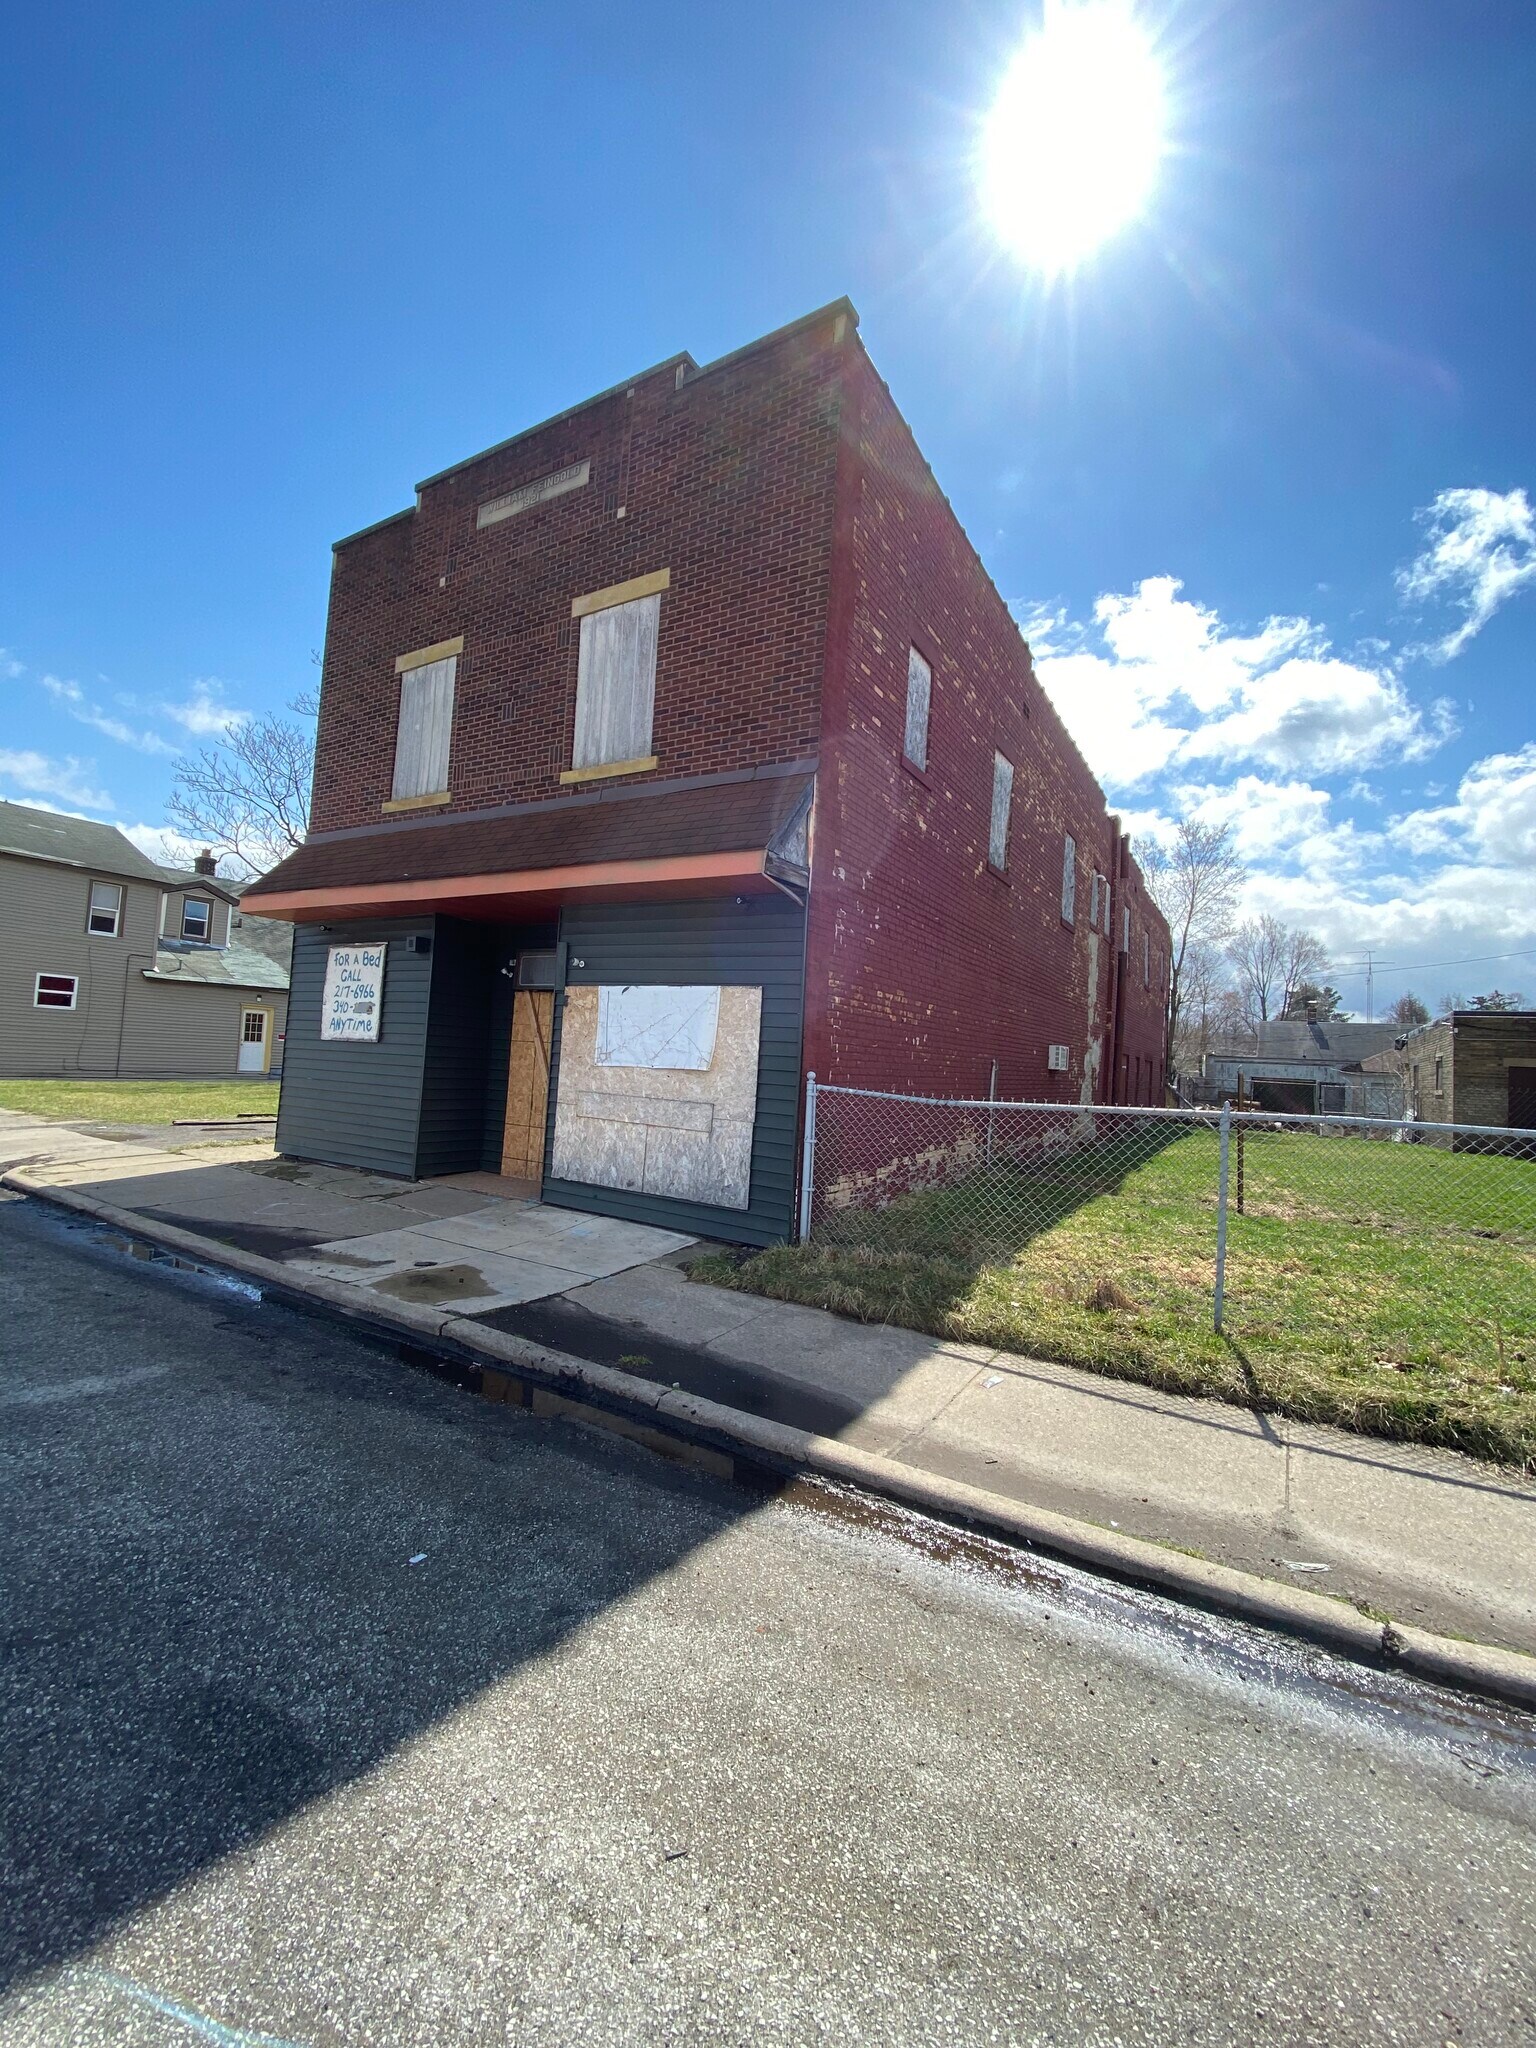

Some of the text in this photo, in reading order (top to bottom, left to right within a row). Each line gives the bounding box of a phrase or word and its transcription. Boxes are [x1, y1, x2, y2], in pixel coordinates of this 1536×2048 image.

[353, 954, 359, 965] A
[362, 950, 382, 968] Bed
[341, 969, 361, 982] CALL
[333, 984, 375, 999] 217-6966
